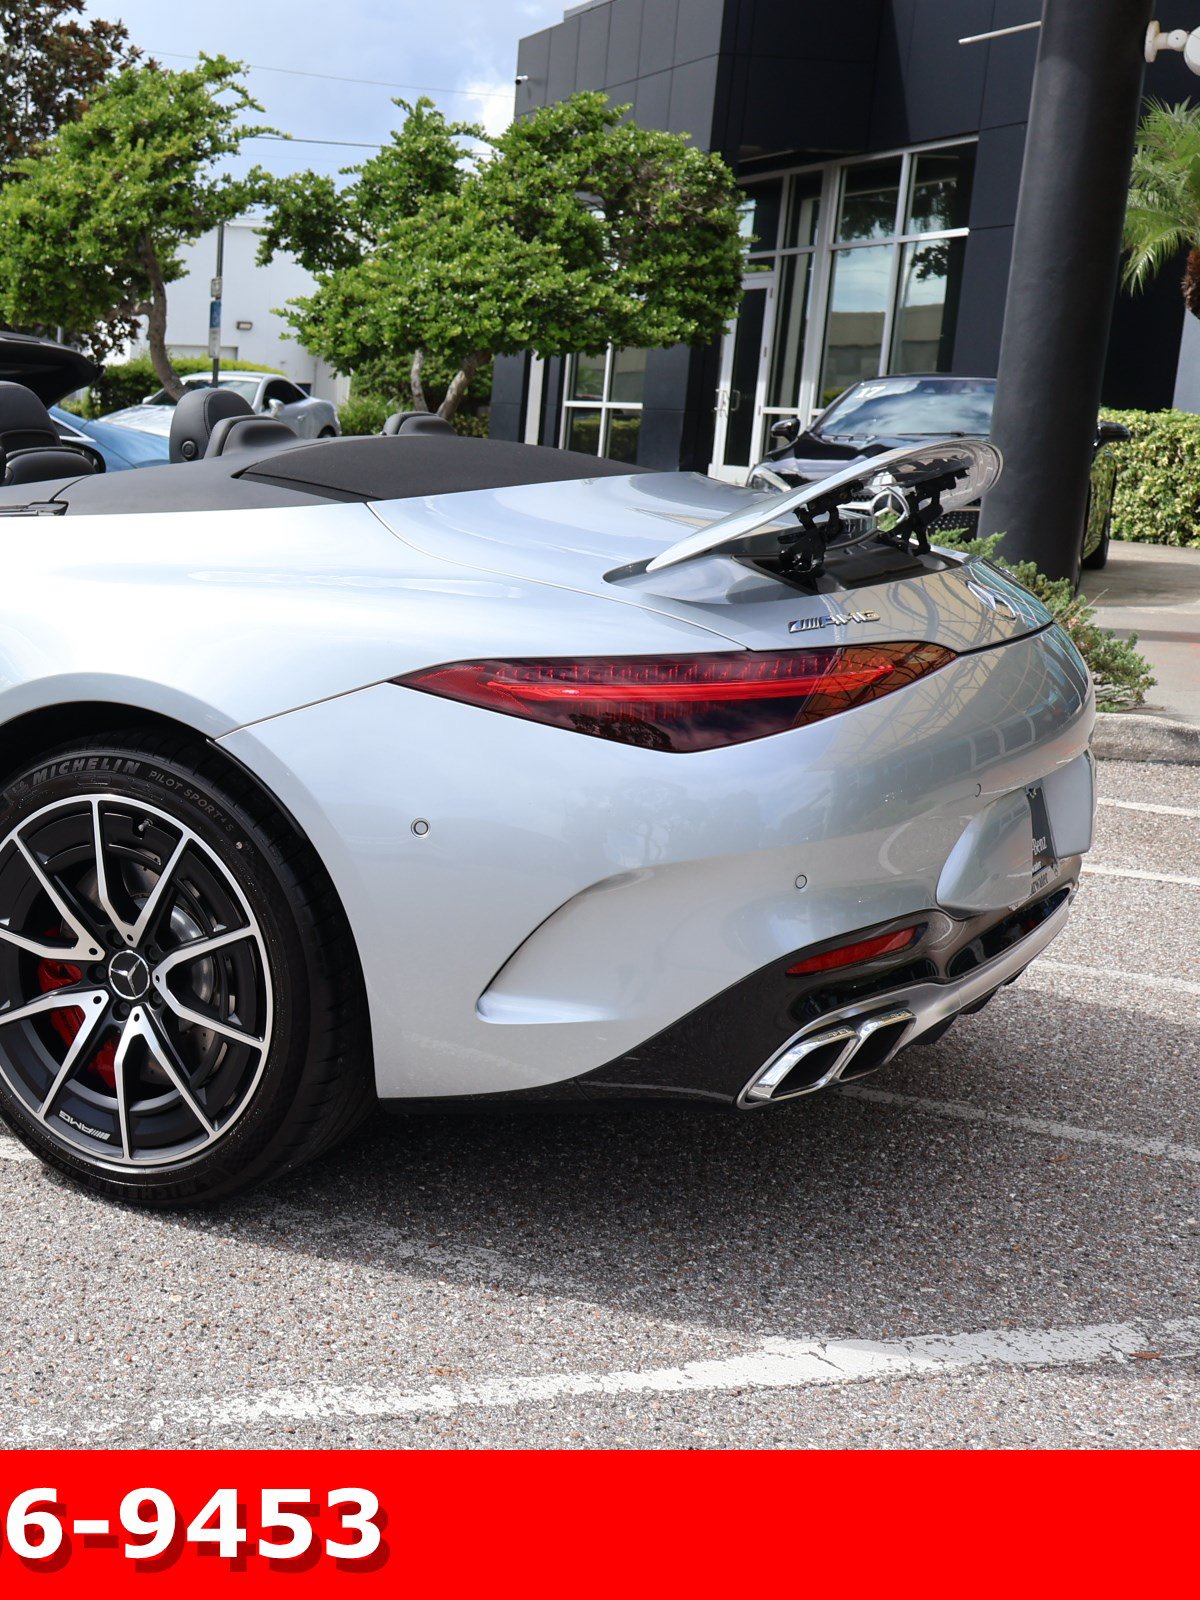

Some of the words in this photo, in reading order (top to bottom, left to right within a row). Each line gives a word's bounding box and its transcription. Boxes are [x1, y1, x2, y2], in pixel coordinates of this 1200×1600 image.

[820, 609, 881, 628] AMG
[33, 757, 140, 786] MICHELIN
[149, 770, 183, 790] PILOT
[183, 788, 223, 818] SPORT
[59, 1110, 94, 1135] AMG
